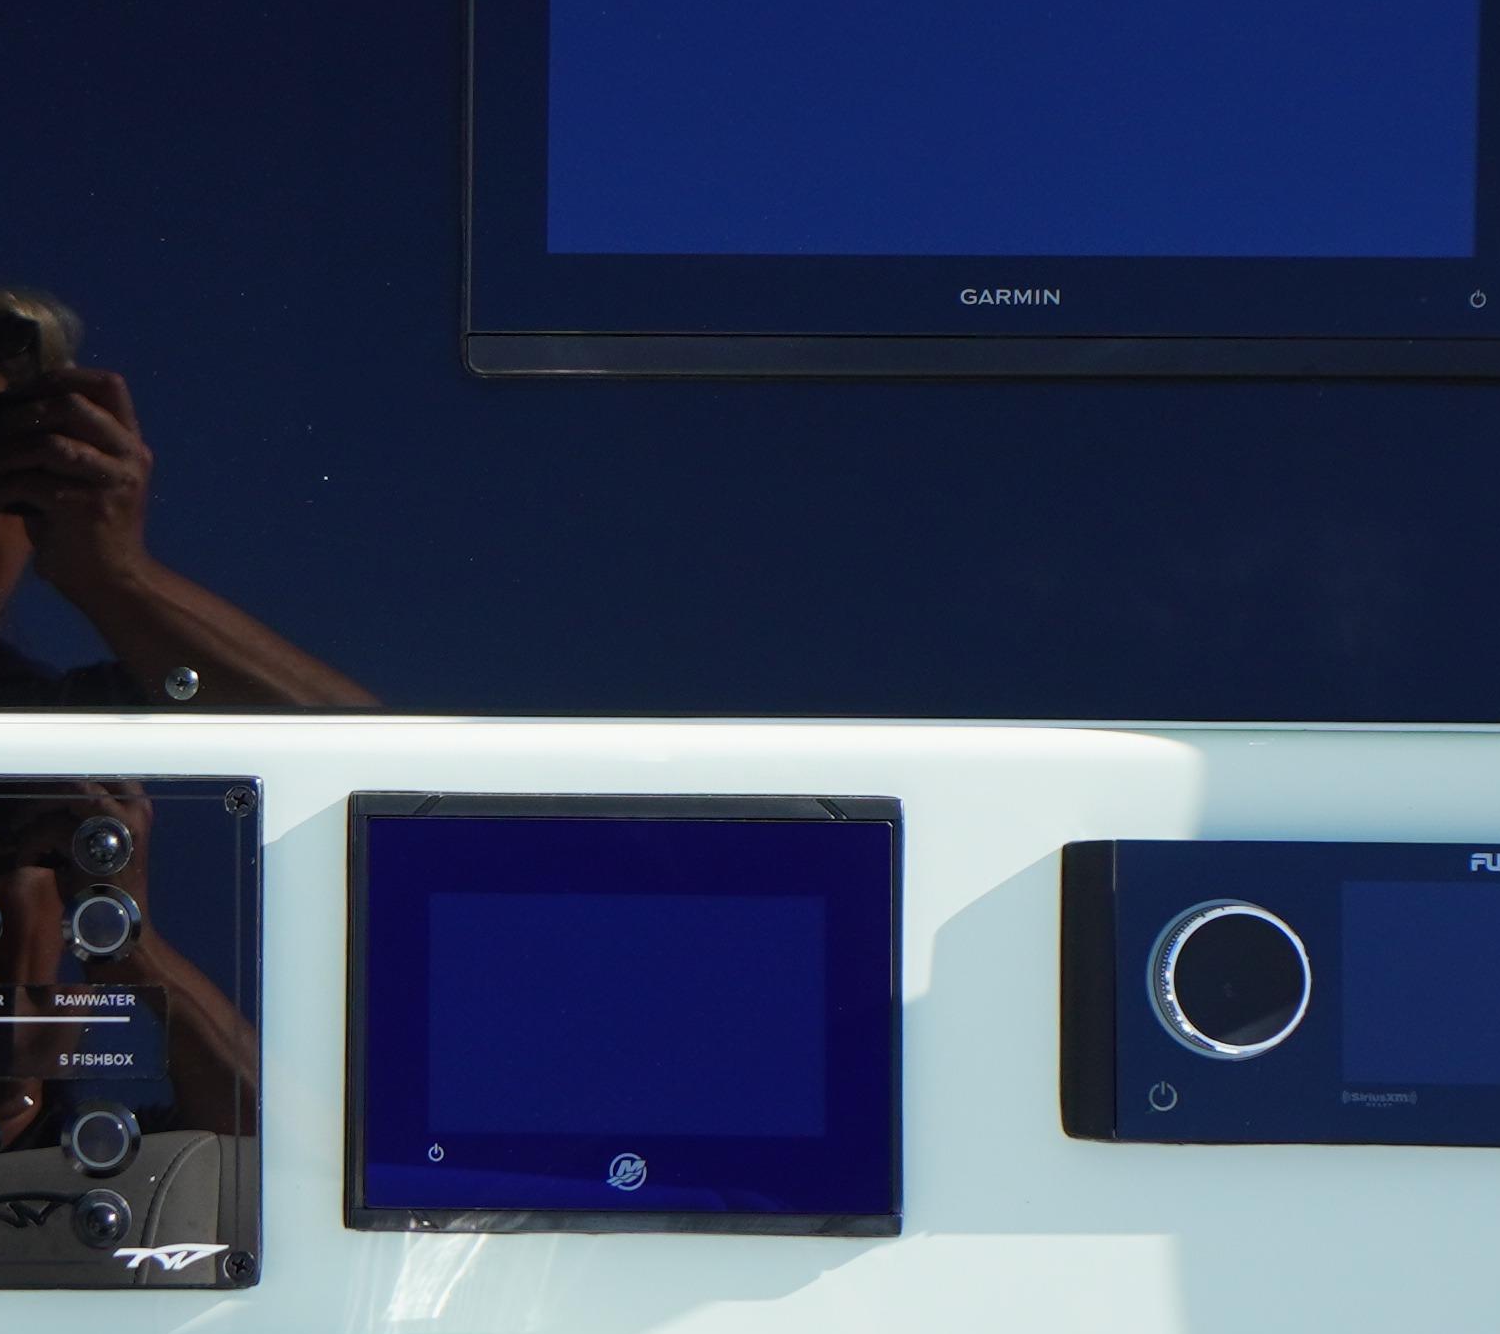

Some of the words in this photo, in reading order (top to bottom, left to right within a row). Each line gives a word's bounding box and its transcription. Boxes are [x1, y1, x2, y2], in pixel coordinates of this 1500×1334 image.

[959, 288, 1061, 306] GARMIN
[54, 993, 137, 1007] RAWWATER
[59, 1053, 70, 1067] S
[73, 1053, 135, 1067] FISHBOX
